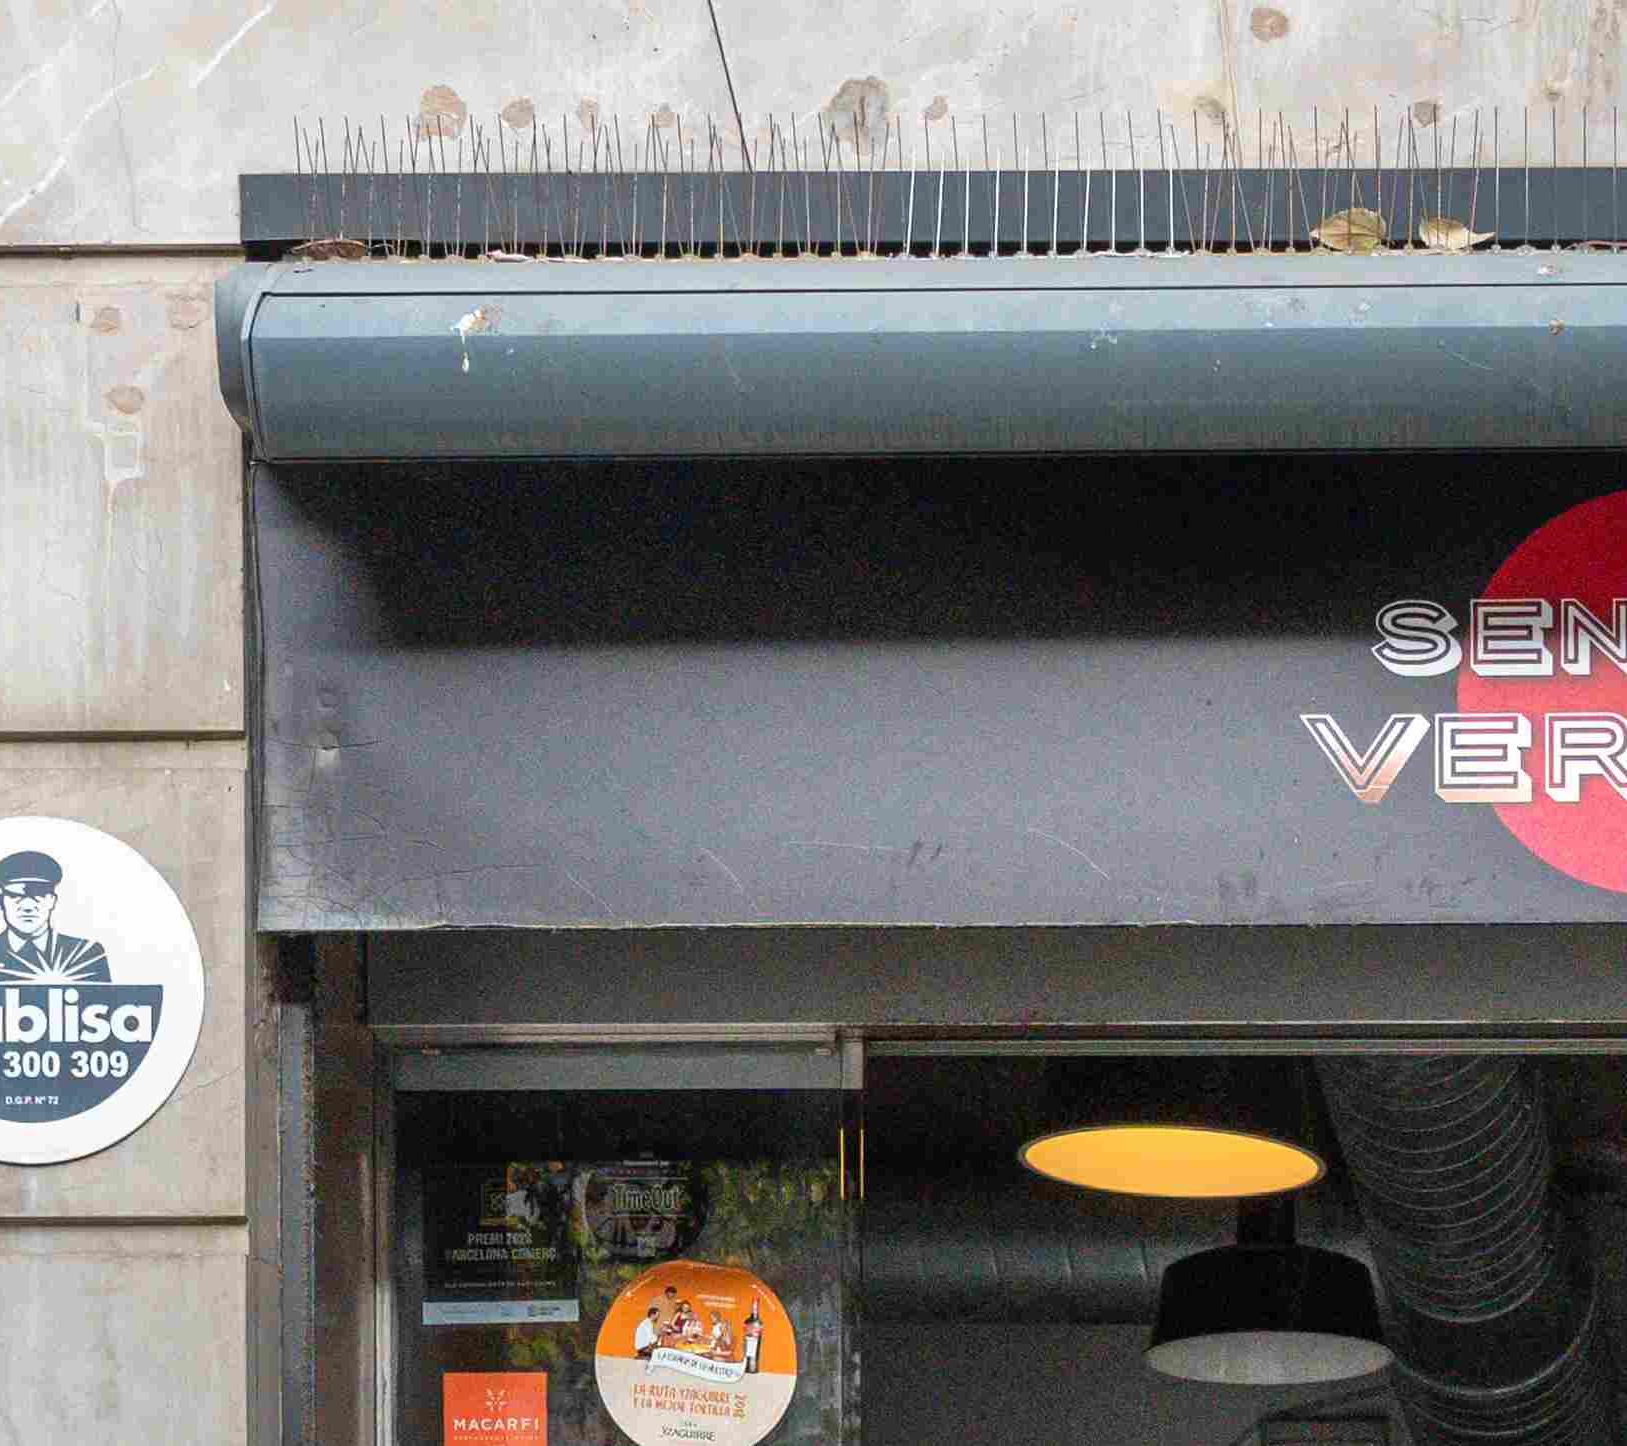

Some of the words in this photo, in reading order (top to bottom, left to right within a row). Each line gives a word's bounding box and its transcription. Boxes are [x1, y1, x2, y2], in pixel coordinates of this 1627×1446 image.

[3, 1050, 61, 1079] 300
[70, 1050, 129, 1079] 309
[453, 1418, 540, 1432] MACARFI
